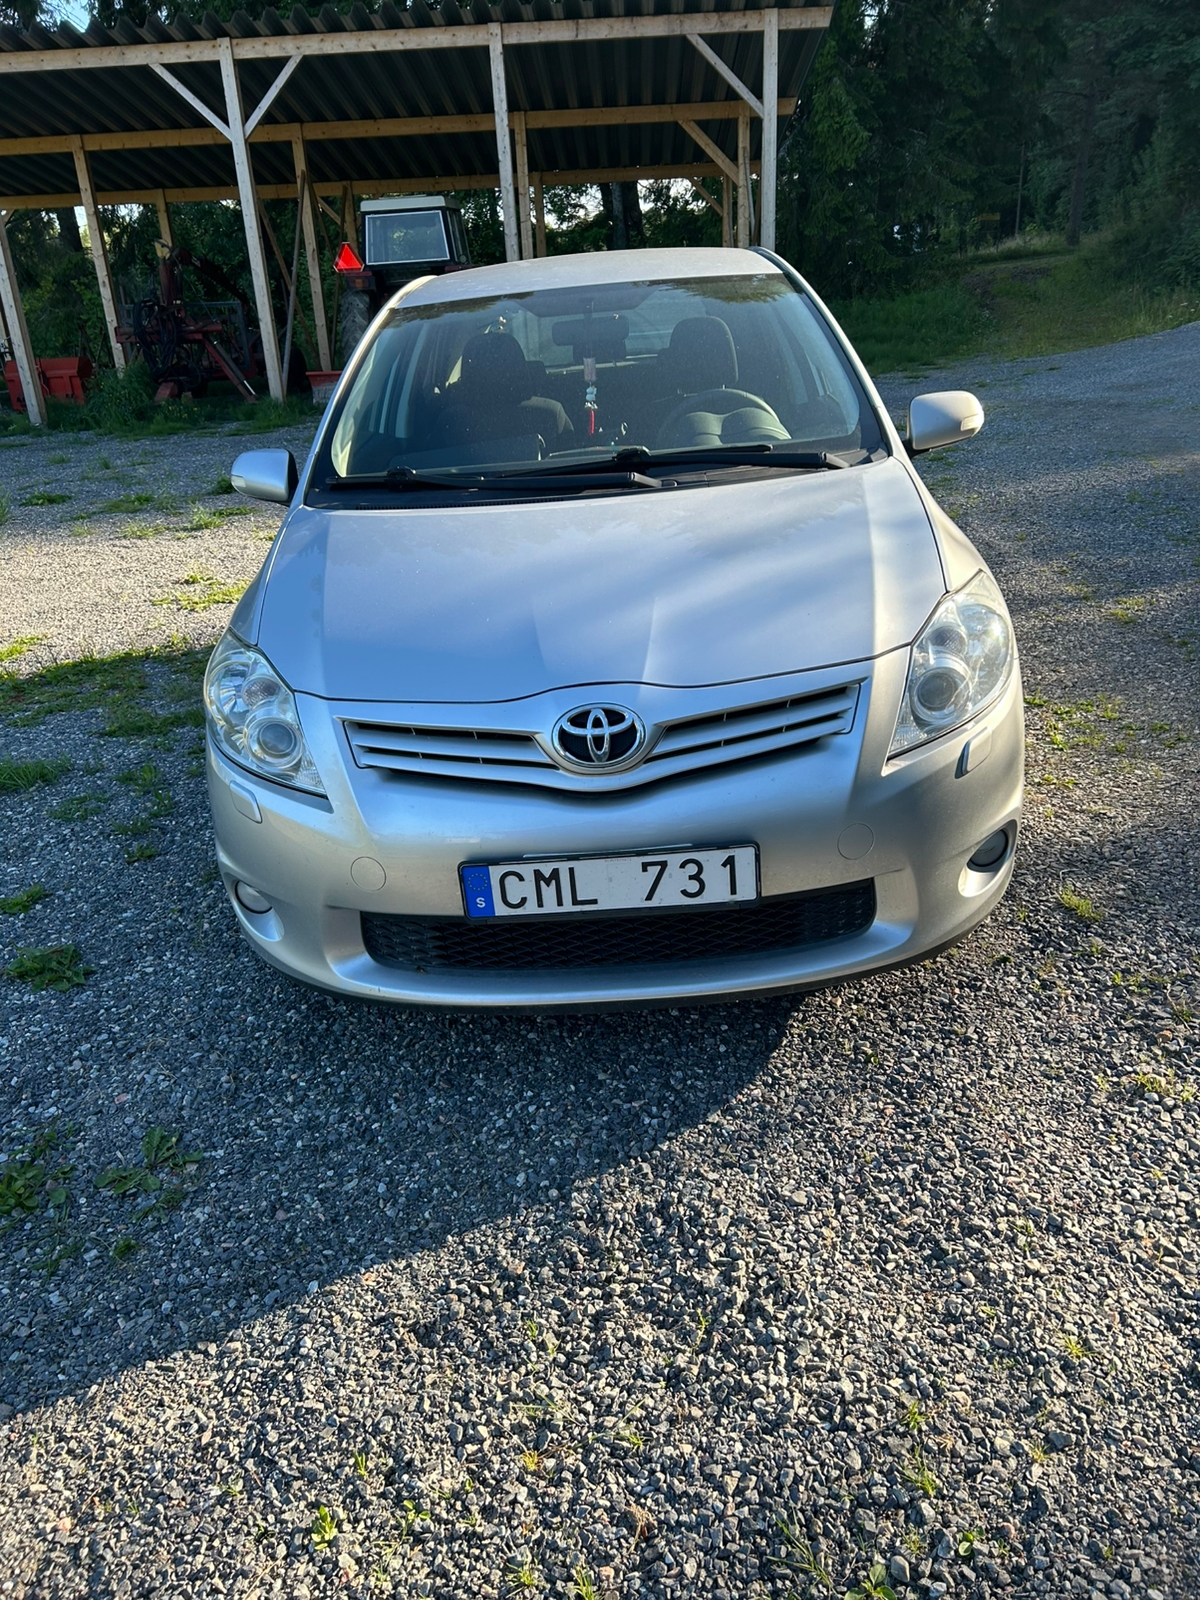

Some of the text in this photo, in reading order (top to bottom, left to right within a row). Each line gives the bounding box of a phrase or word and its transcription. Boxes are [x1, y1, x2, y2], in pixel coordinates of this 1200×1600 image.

[499, 854, 737, 909] CML 731
[475, 897, 487, 908] S
